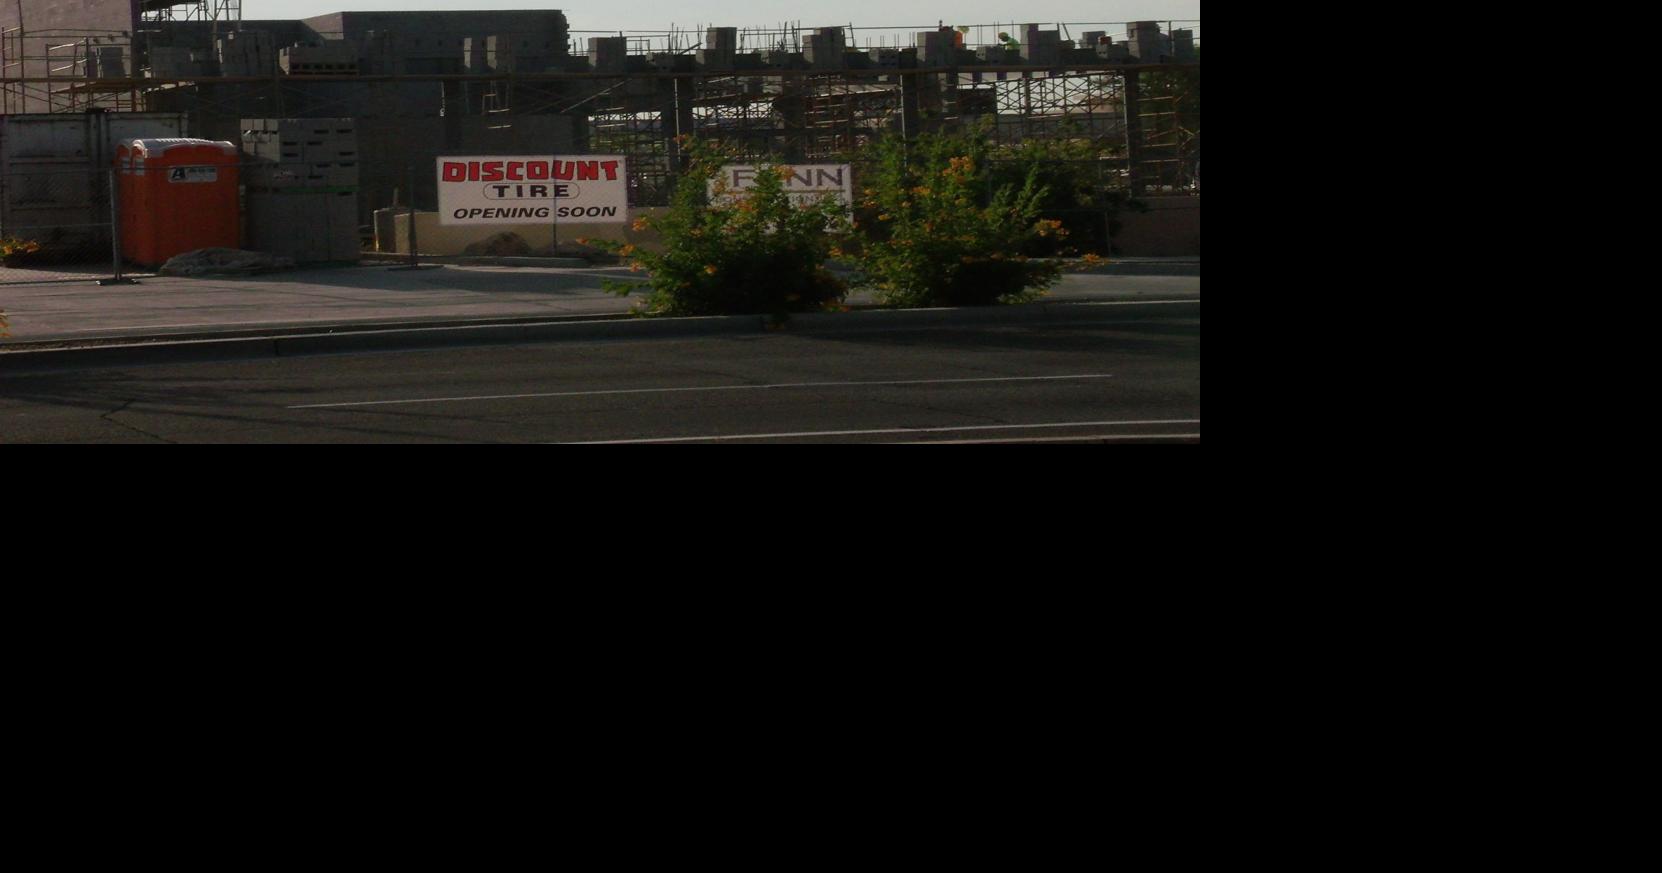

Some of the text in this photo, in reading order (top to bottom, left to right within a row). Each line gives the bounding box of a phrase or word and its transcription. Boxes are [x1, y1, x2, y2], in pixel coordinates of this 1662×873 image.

[442, 160, 618, 182] DISCOUNT
[732, 168, 843, 187] FNN
[492, 184, 570, 198] TIRE
[453, 206, 617, 219] OPENING SOON
